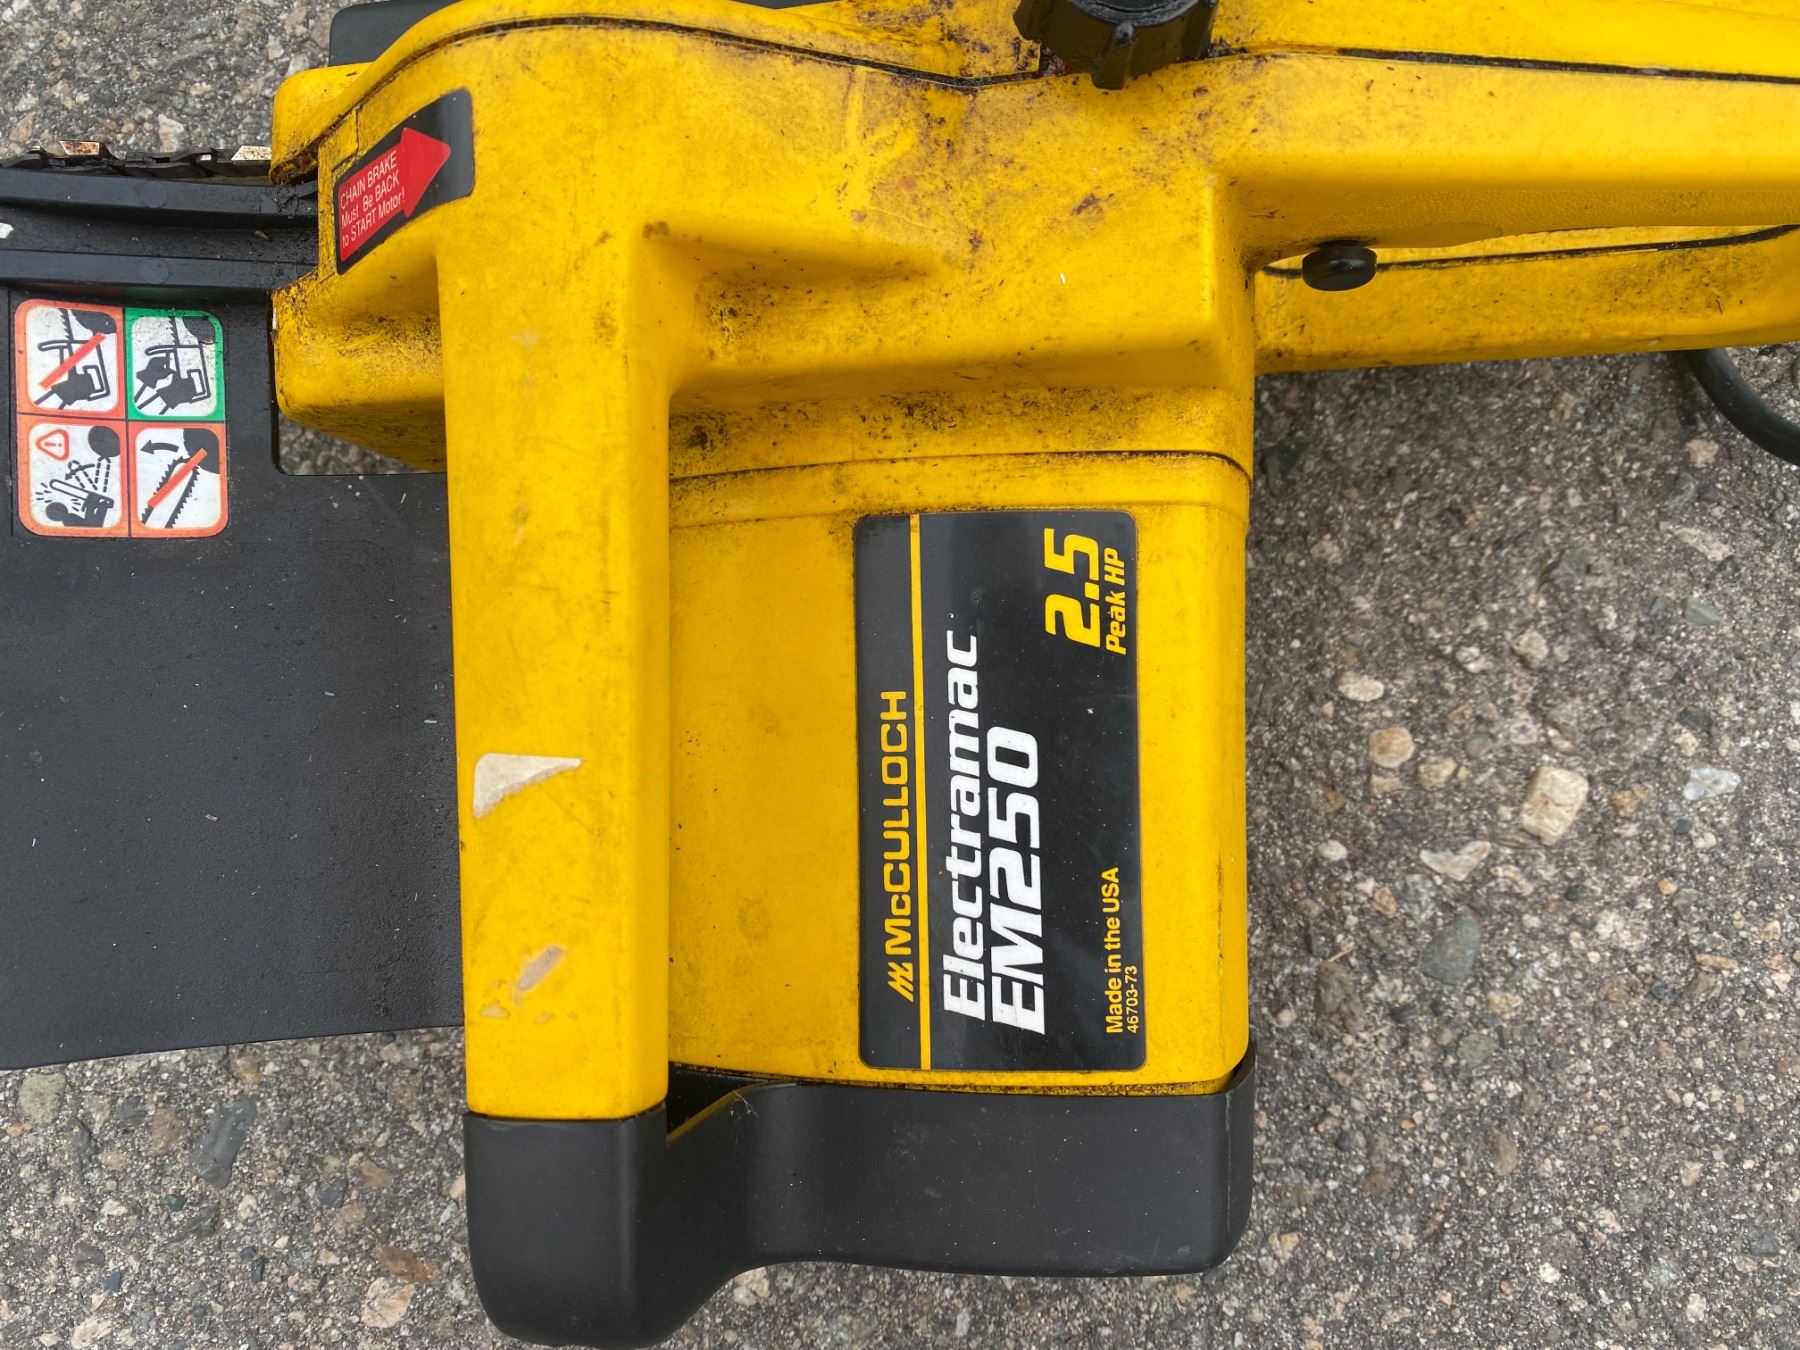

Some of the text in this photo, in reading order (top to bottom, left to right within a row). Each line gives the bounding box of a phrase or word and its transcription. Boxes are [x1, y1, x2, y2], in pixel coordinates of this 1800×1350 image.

[340, 150, 398, 210] CHAIN BRAKE
[341, 170, 400, 230] Must Be BACK
[342, 186, 405, 248] to START Motor!
[1043, 528, 1101, 648] 2.5
[1104, 547, 1127, 655] Peak HP
[880, 691, 912, 955] McCULLOCH
[943, 630, 986, 1021] Electramac
[986, 726, 1045, 1035] EM250
[1101, 867, 1124, 1033] Made in the USA
[1125, 965, 1138, 1034] 46703-73
